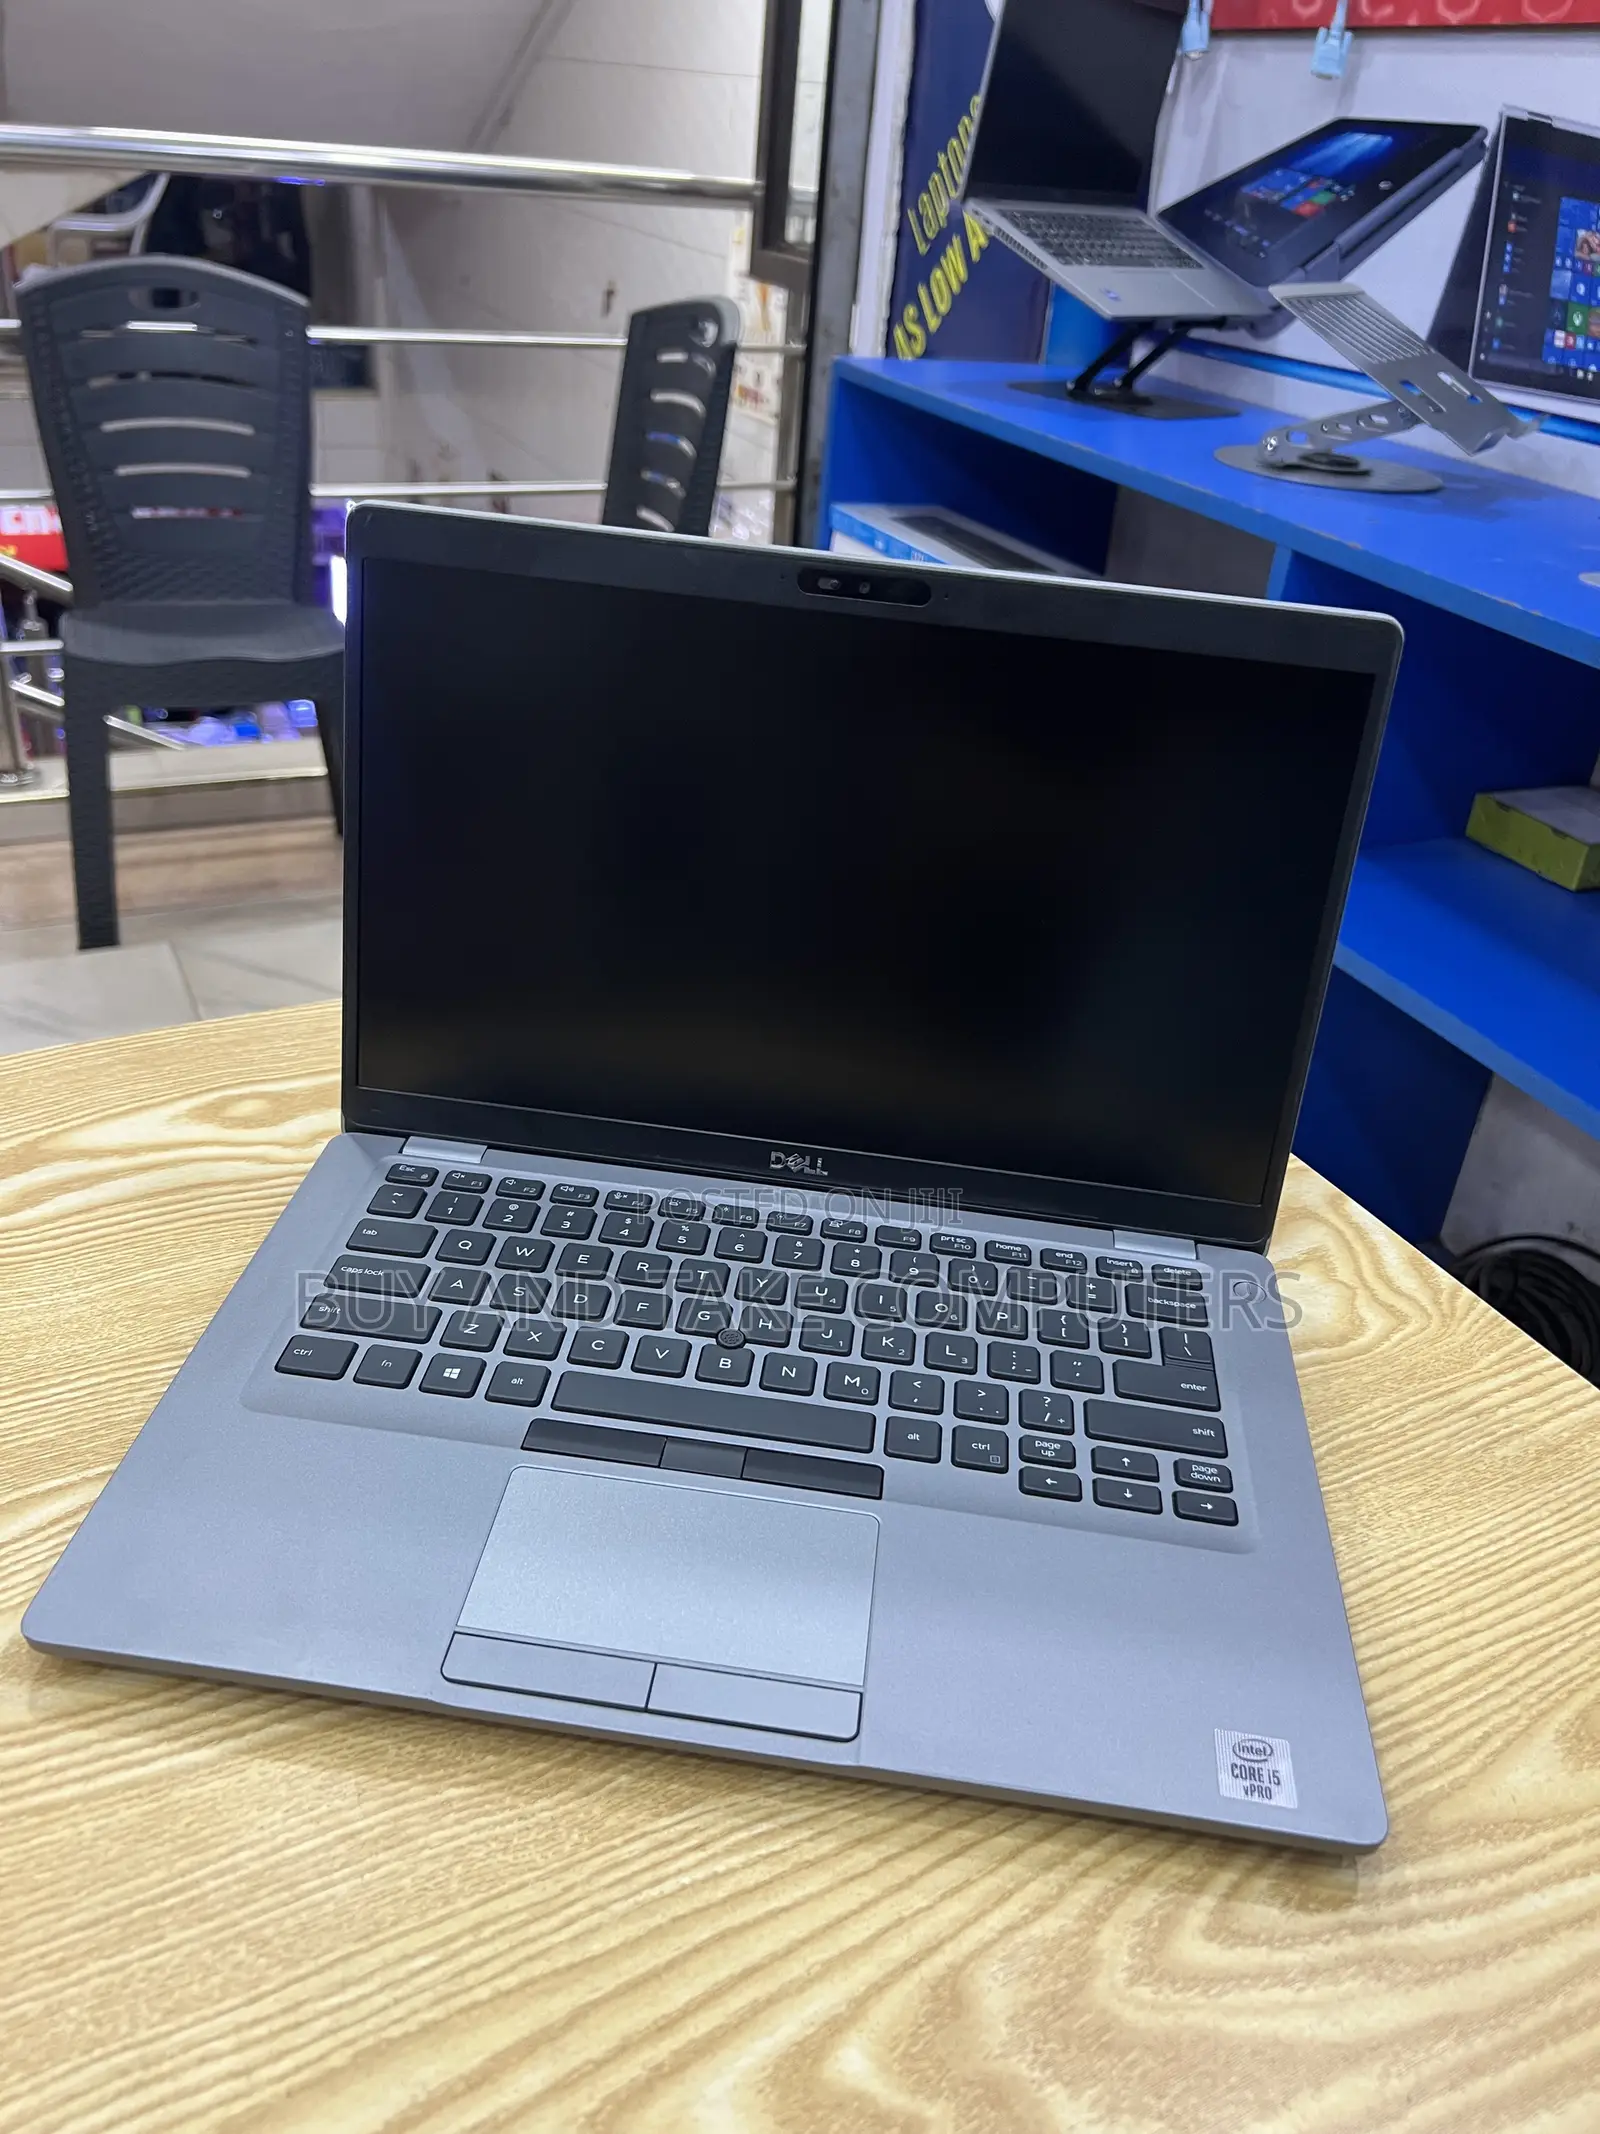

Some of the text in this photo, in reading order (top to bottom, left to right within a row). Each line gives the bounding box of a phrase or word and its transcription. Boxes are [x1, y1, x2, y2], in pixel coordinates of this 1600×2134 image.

[917, 233, 968, 334] LOW
[769, 1151, 829, 1176] DELL
[399, 1165, 416, 1173] Esc
[561, 1221, 571, 1229] 3
[363, 1228, 377, 1236] tab
[458, 1240, 472, 1250] Q
[677, 1236, 687, 1244] 5
[516, 1246, 535, 1257] W
[995, 1243, 1022, 1251] home
[577, 1254, 590, 1264] E
[1055, 1251, 1073, 1259] end
[636, 1262, 649, 1272] R
[850, 1259, 860, 1268] 8
[1106, 1258, 1133, 1267] insert
[341, 1264, 384, 1277] caps lock
[697, 1271, 709, 1280] T
[909, 1267, 919, 1275] 9
[1163, 1266, 1192, 1276] delete
[450, 1279, 465, 1289] A
[756, 1278, 769, 1287] Y
[513, 1286, 527, 1297] S
[815, 1286, 828, 1296] U
[573, 1294, 588, 1304] D
[1147, 1296, 1196, 1309] backspace
[319, 1304, 341, 1314] shift
[636, 1302, 649, 1312] F
[698, 1311, 711, 1321] G
[996, 1312, 1008, 1321] P
[758, 1318, 773, 1330] H
[464, 1324, 479, 1335] Z
[821, 1329, 833, 1339] J
[528, 1331, 543, 1343] X
[882, 1336, 894, 1348] K
[591, 1340, 605, 1350] C
[293, 1347, 313, 1357] ctrl
[655, 1348, 670, 1359] V
[945, 1345, 956, 1356] L
[381, 1359, 392, 1369] fn
[719, 1357, 732, 1369] B
[782, 1366, 796, 1378] N
[510, 1377, 525, 1386] alt
[844, 1375, 860, 1387] M
[1180, 1382, 1207, 1392] enter
[907, 1432, 920, 1441] alt
[1192, 1426, 1216, 1437] shift
[971, 1442, 990, 1451] ctrl
[1035, 1439, 1061, 1450] page
[1041, 1450, 1055, 1458] up
[1191, 1464, 1218, 1475] page
[1190, 1472, 1221, 1483] down
[1237, 1741, 1268, 1756] intel
[1230, 1762, 1265, 1784] CORE
[1243, 1783, 1273, 1801] vPRO
